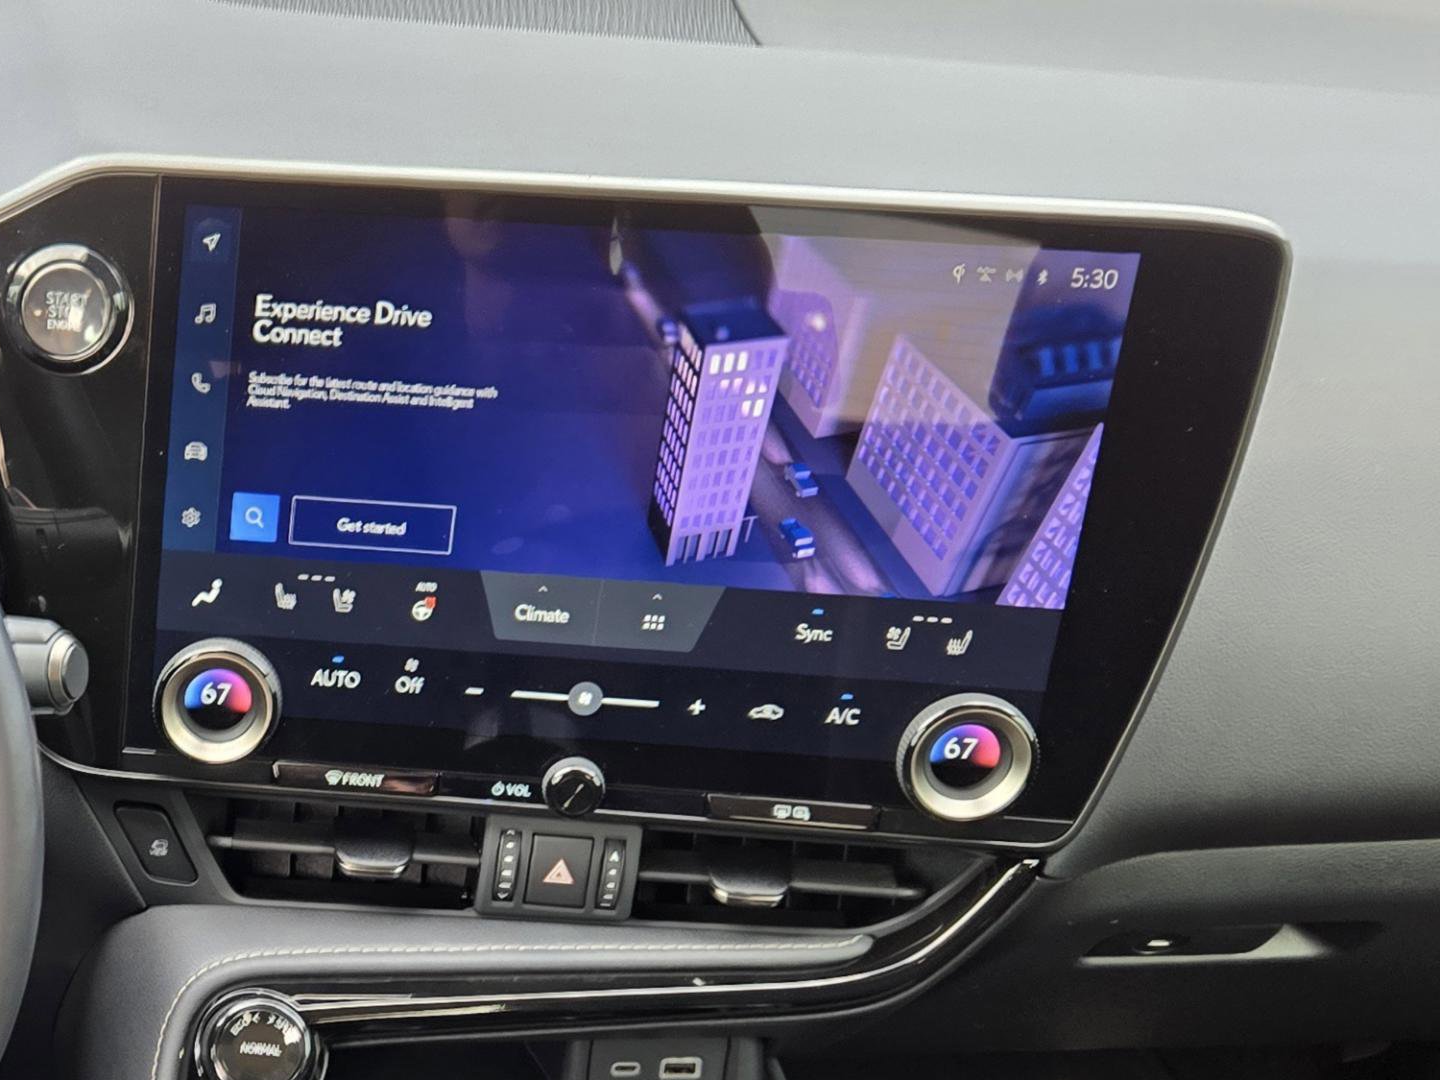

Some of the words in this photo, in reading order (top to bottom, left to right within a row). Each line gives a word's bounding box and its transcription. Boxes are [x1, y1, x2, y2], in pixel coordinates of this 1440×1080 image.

[1070, 268, 1119, 289] 5:30
[254, 294, 371, 324] Experience
[374, 300, 432, 328] Drive
[252, 319, 344, 347] Connect
[294, 374, 309, 386] for
[309, 375, 325, 388] the
[337, 517, 363, 533] Get
[363, 522, 407, 536] started
[415, 582, 438, 593] AUTO
[514, 603, 570, 624] Climate
[794, 623, 833, 643] Sync
[311, 669, 361, 688] AUTO
[395, 675, 425, 694] Off
[200, 682, 232, 705] 67
[824, 707, 861, 725] A/C
[944, 737, 979, 760] 67
[342, 772, 385, 787] FRONT
[506, 783, 531, 797] VOL
[240, 1041, 282, 1058] NORMAL
